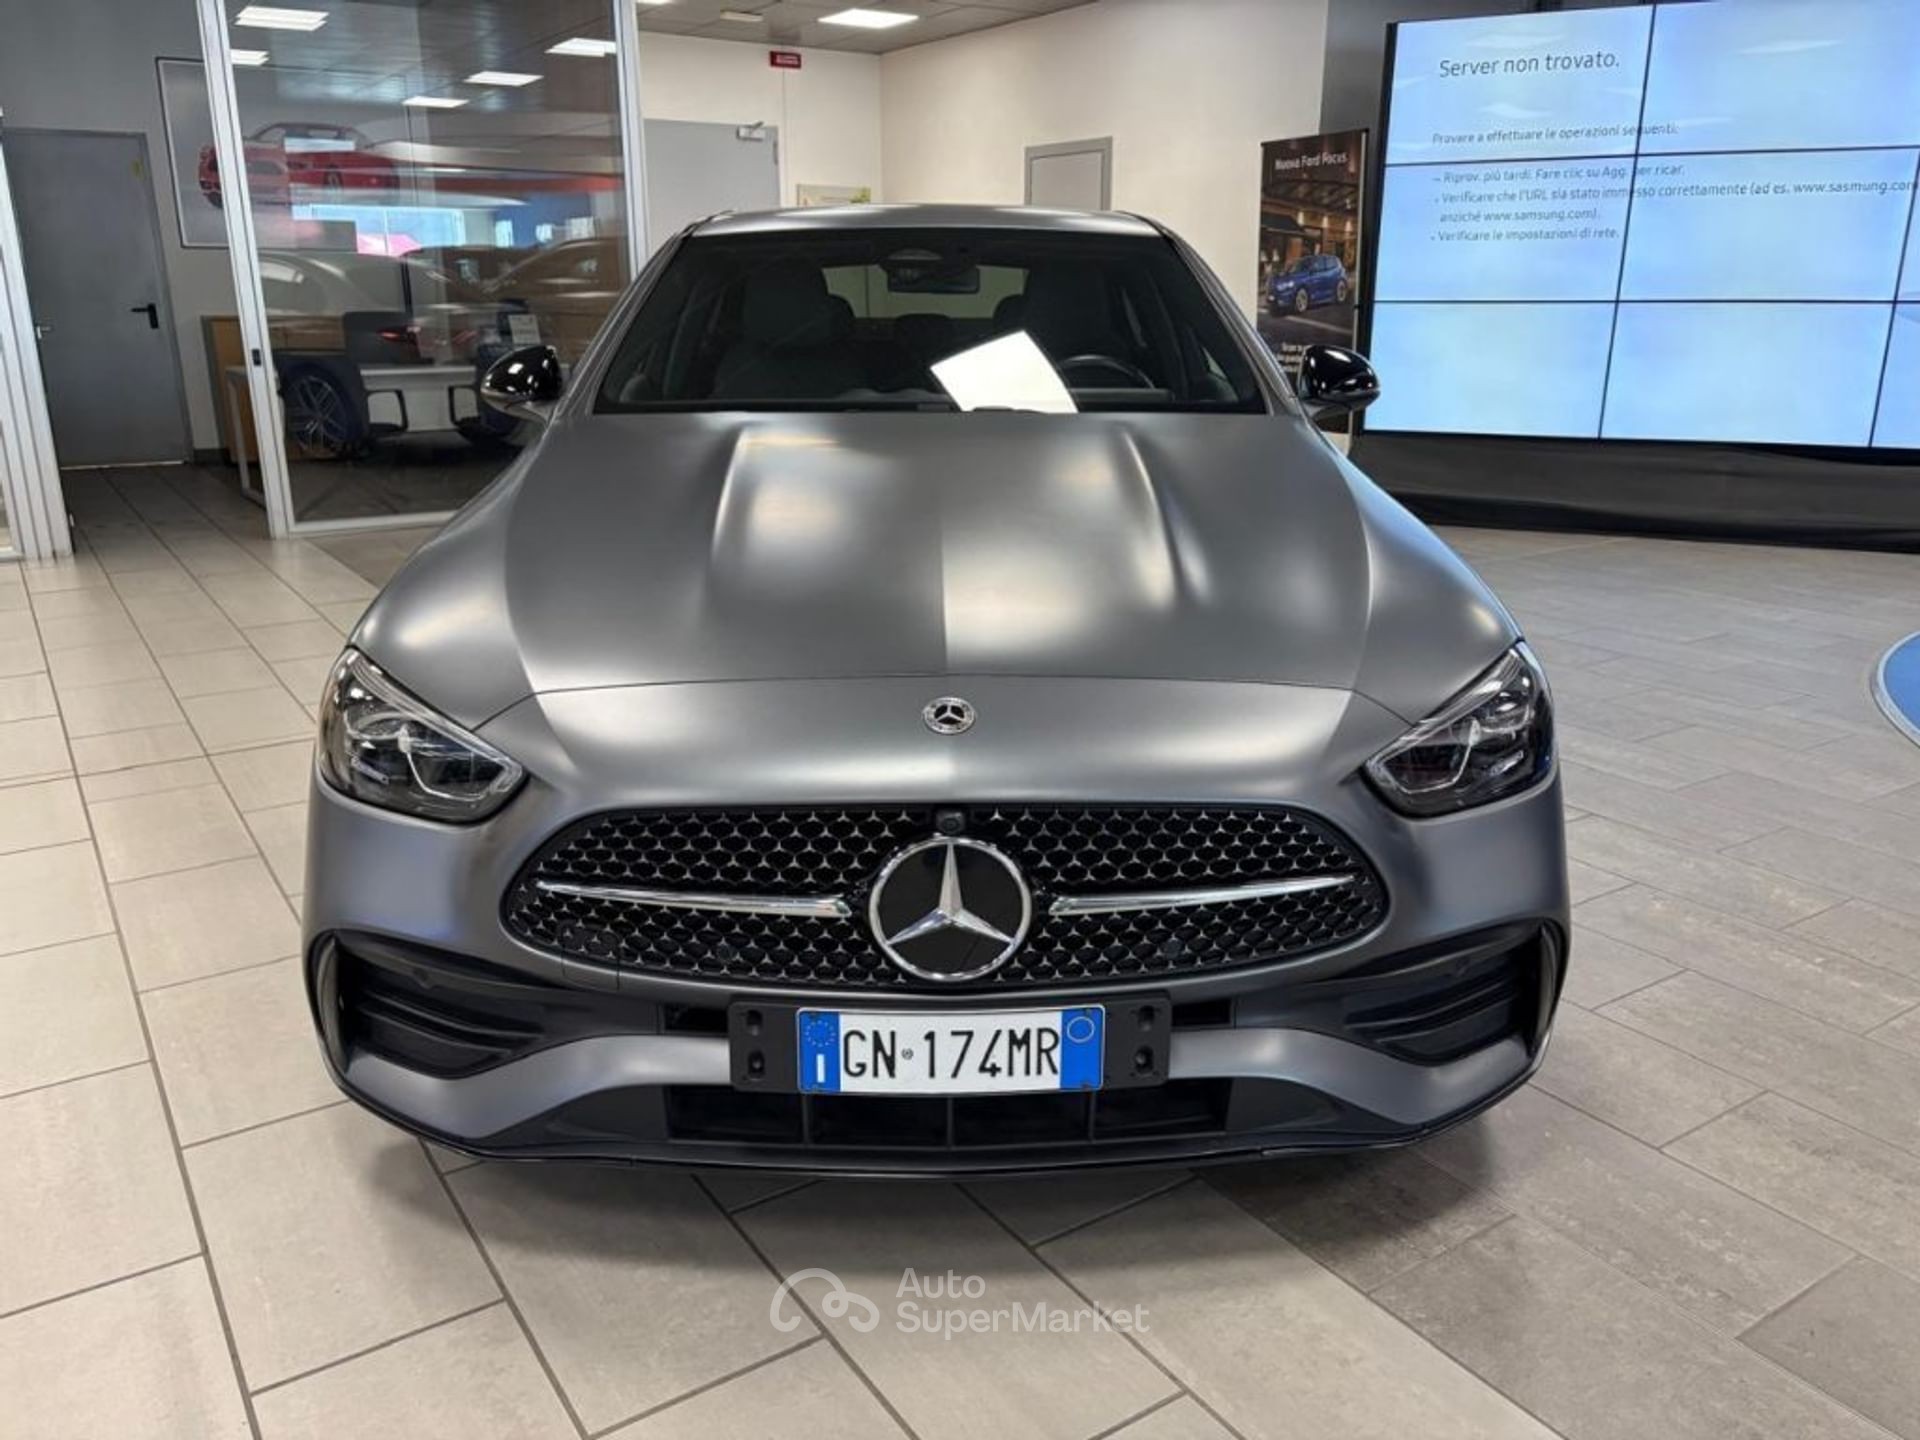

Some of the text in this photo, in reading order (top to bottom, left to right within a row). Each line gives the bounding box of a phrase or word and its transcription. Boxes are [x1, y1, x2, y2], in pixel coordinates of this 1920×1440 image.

[1439, 51, 1620, 78] Server non trovato.
[1432, 133, 1475, 144] Provare
[1486, 129, 1543, 142] effettuare
[1545, 128, 1556, 139] le
[1558, 125, 1620, 140] operazioni
[1622, 122, 1679, 138] seuenti:
[1301, 154, 1321, 167] Ford
[1322, 152, 1347, 165] Focus
[1535, 168, 1561, 180] Fare
[1563, 168, 1584, 178] clic
[1586, 168, 1599, 178] su
[1442, 191, 1495, 203] Verificare
[1497, 190, 1517, 201] che
[1552, 187, 1568, 199] sia
[1570, 186, 1600, 198] stato
[1602, 187, 1655, 199] immsso
[1658, 183, 1747, 197] correttamente
[1750, 181, 1769, 195] (ad
[1440, 211, 1482, 222] anziché
[1438, 227, 1620, 241] Verificare le impostazioni di rete.
[843, 1027, 1060, 1079] GN 174MR
